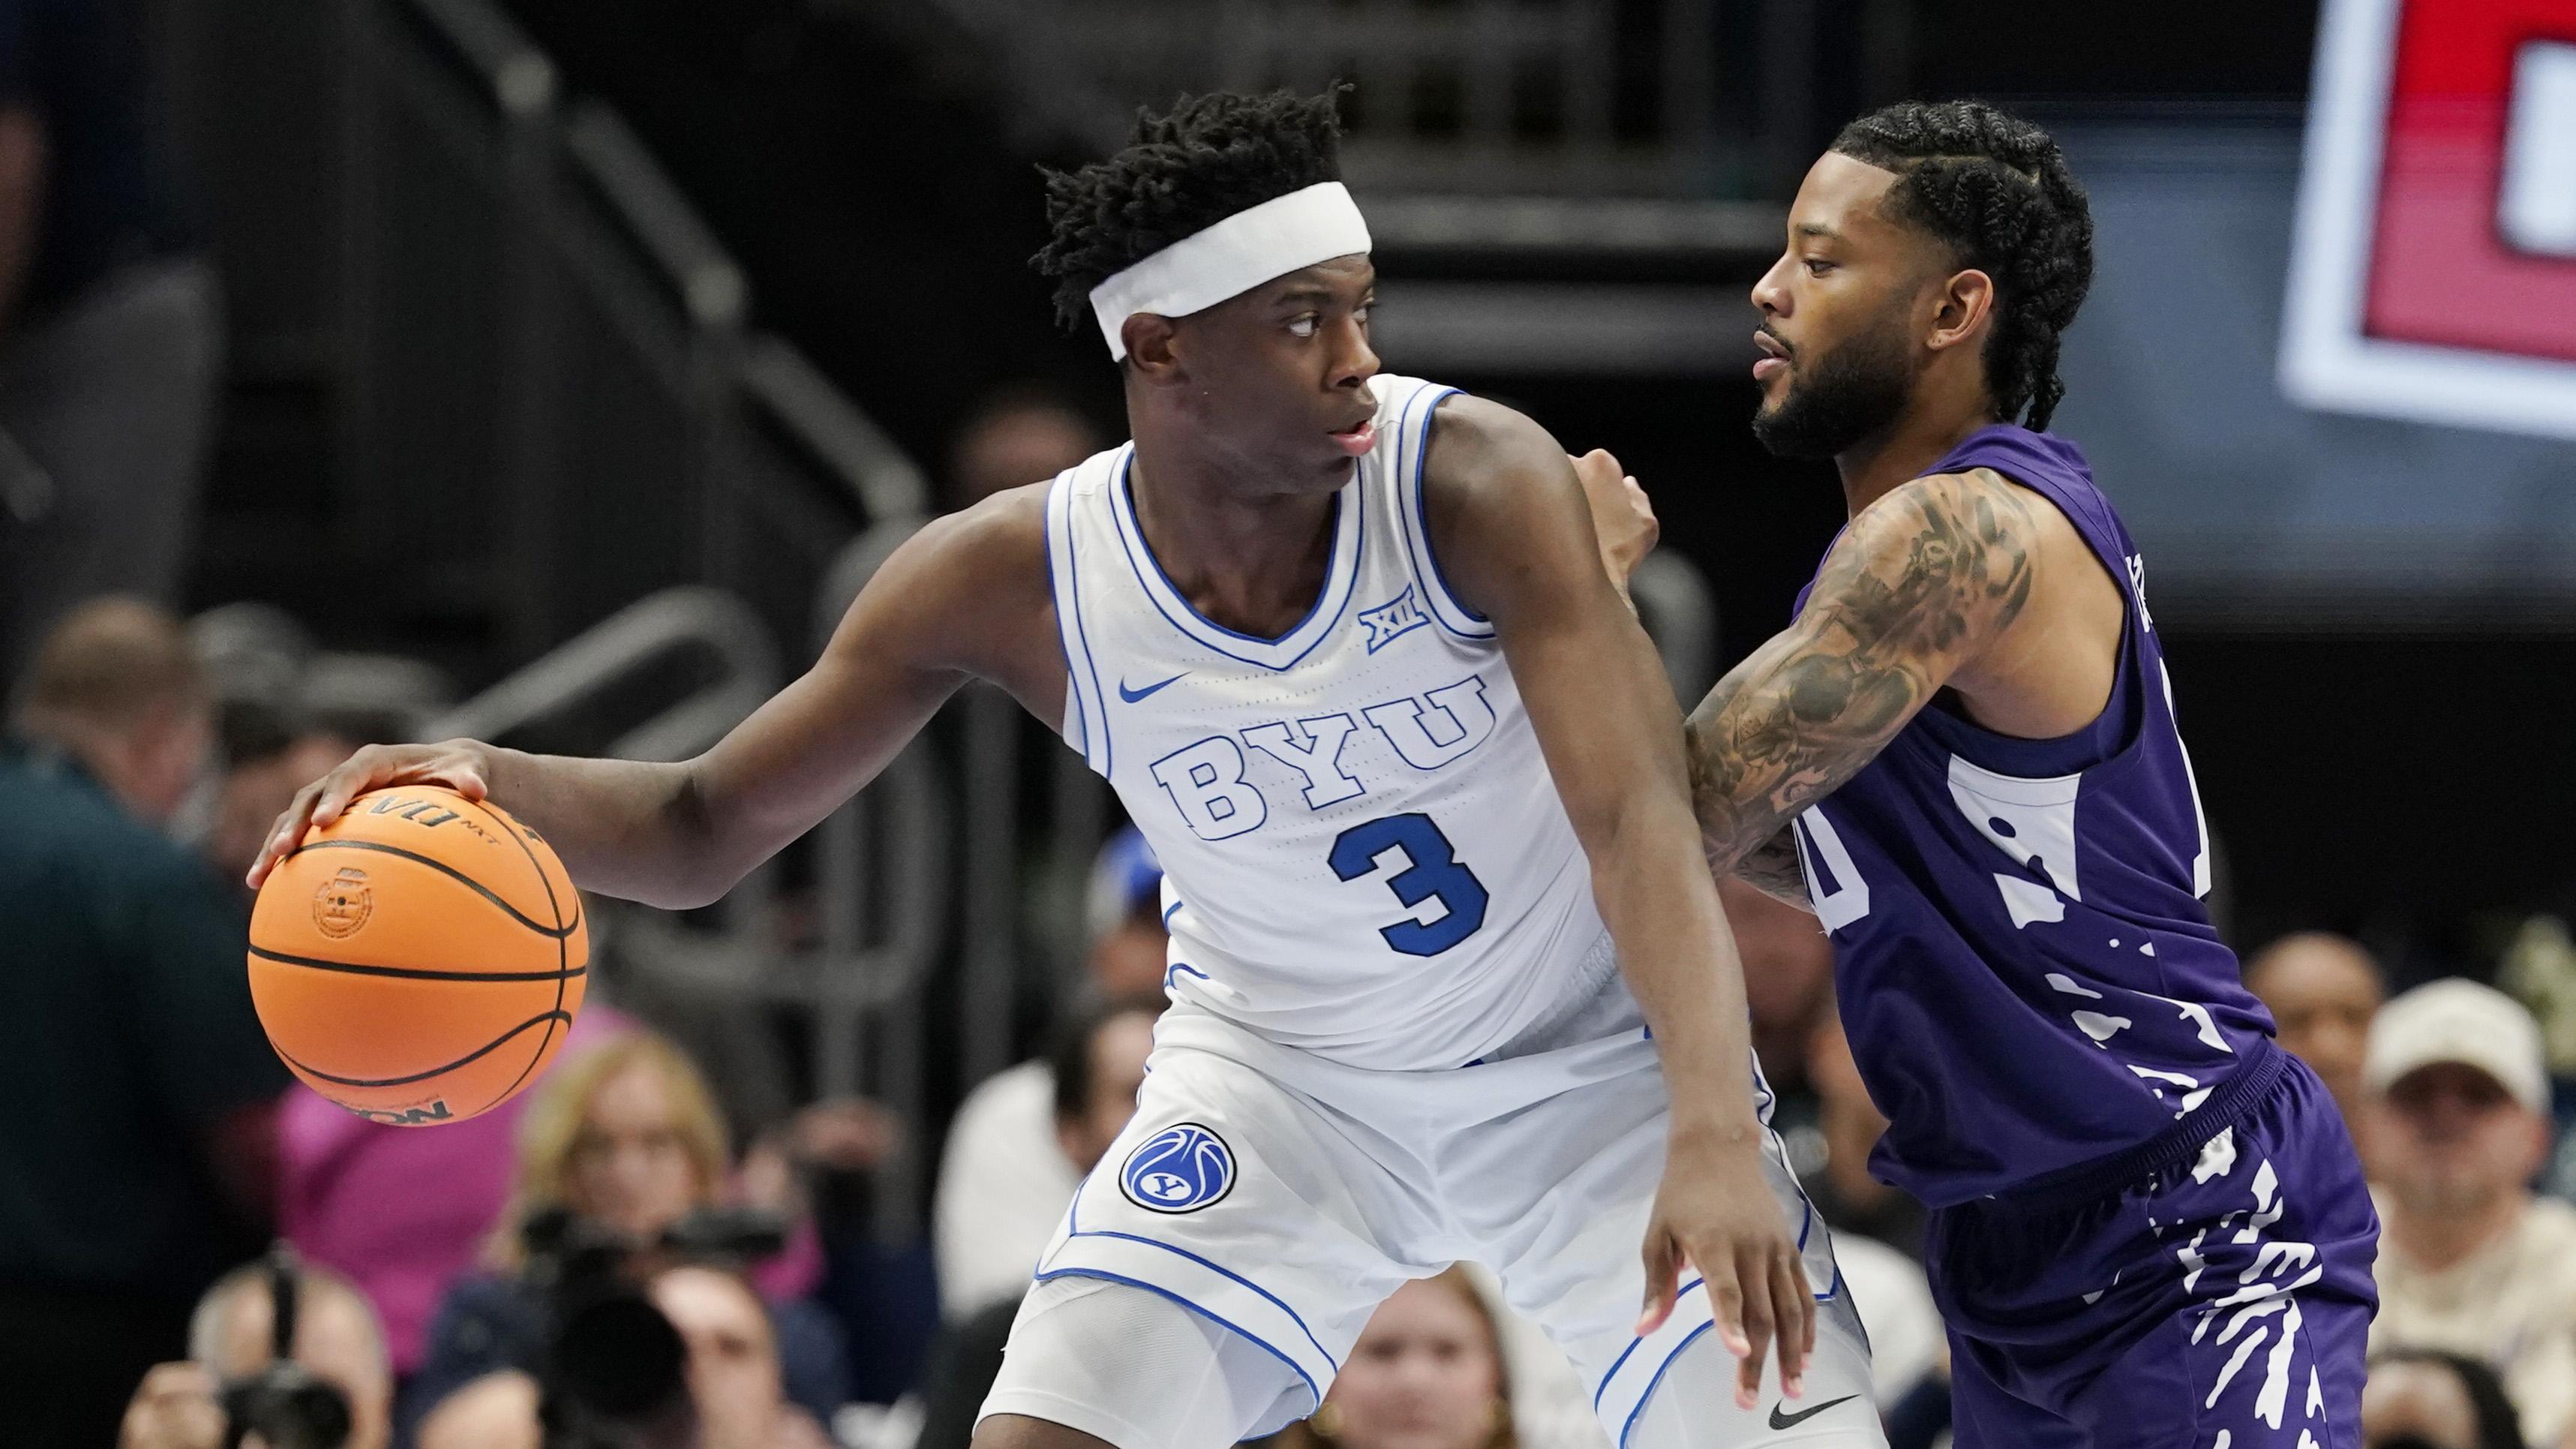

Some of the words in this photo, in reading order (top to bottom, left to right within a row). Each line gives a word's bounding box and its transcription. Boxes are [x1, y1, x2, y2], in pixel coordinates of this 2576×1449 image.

[1149, 674, 1496, 841] BYU
[340, 795, 461, 827] VO
[1327, 812, 1490, 957] 3
[1153, 1175, 1185, 1197] Y
